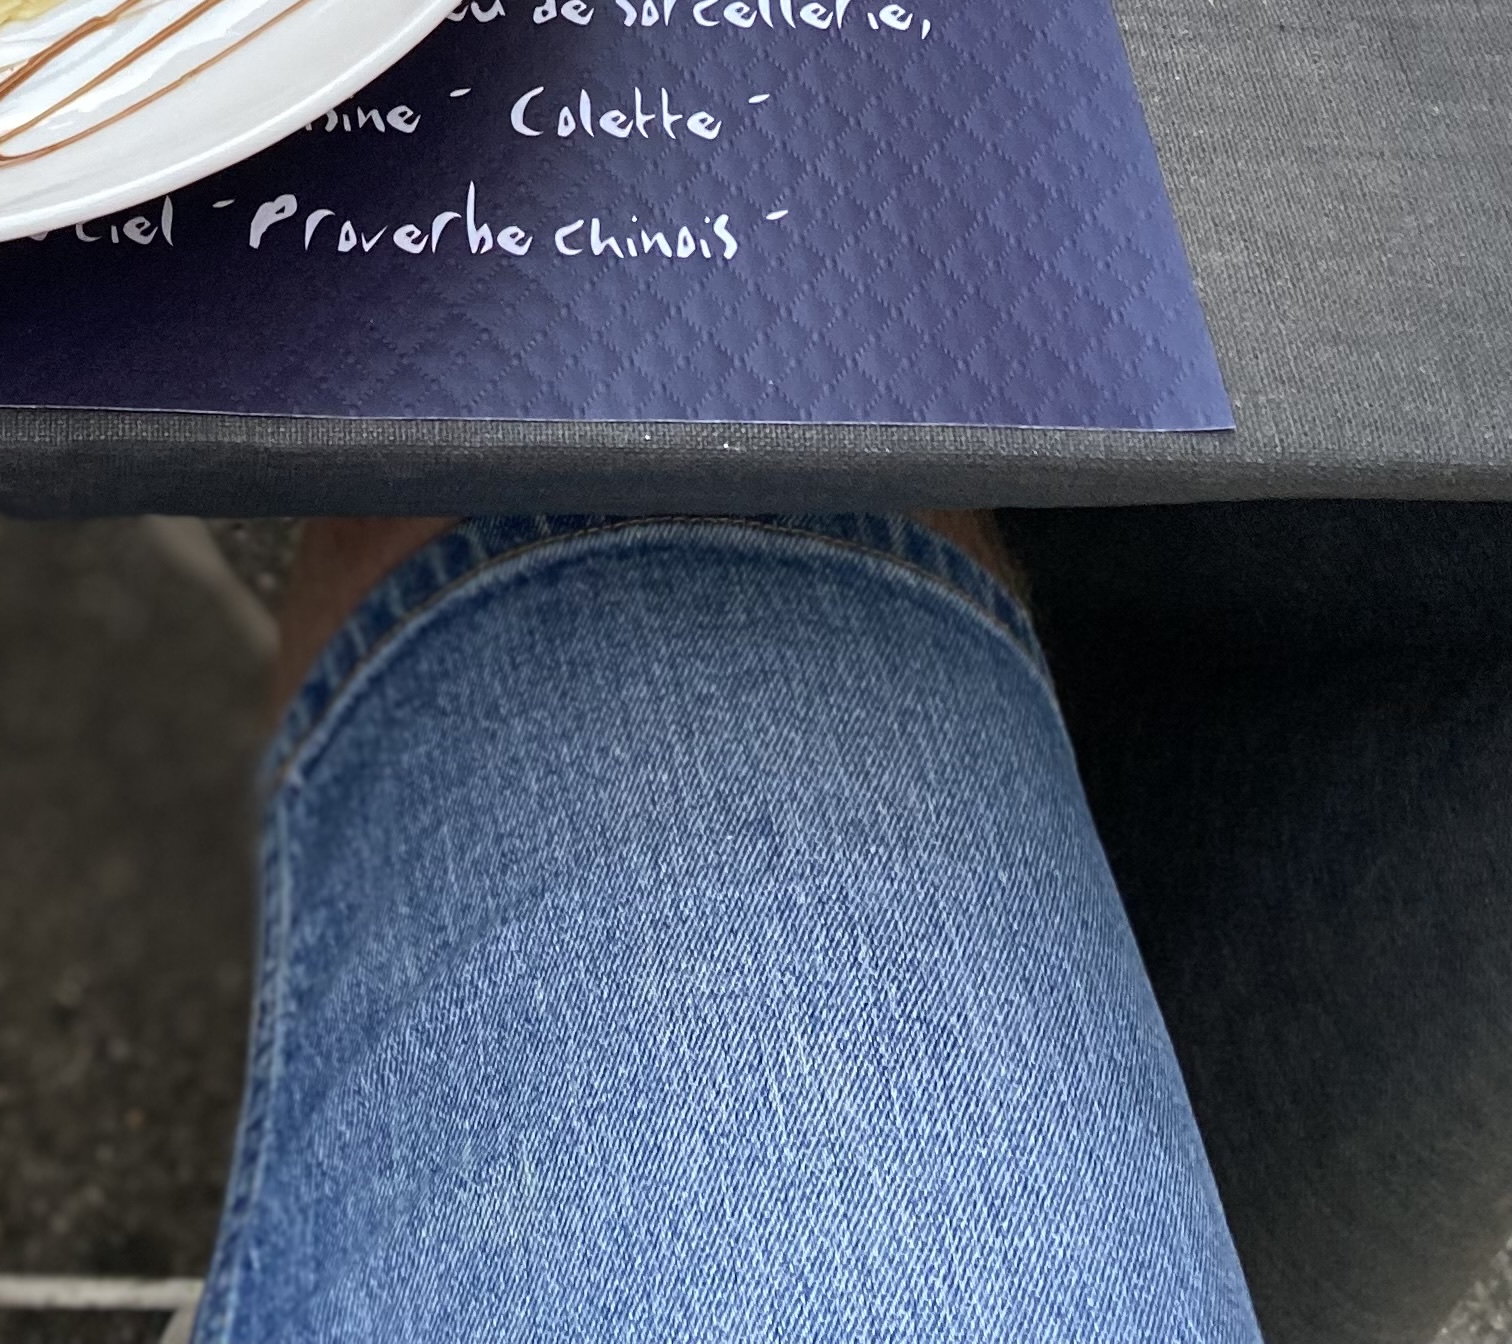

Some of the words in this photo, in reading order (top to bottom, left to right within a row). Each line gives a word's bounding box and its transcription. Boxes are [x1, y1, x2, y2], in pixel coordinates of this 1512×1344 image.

[510, 86, 722, 140] Colette
[249, 180, 533, 256] Proverbe
[554, 213, 739, 260] chinois
